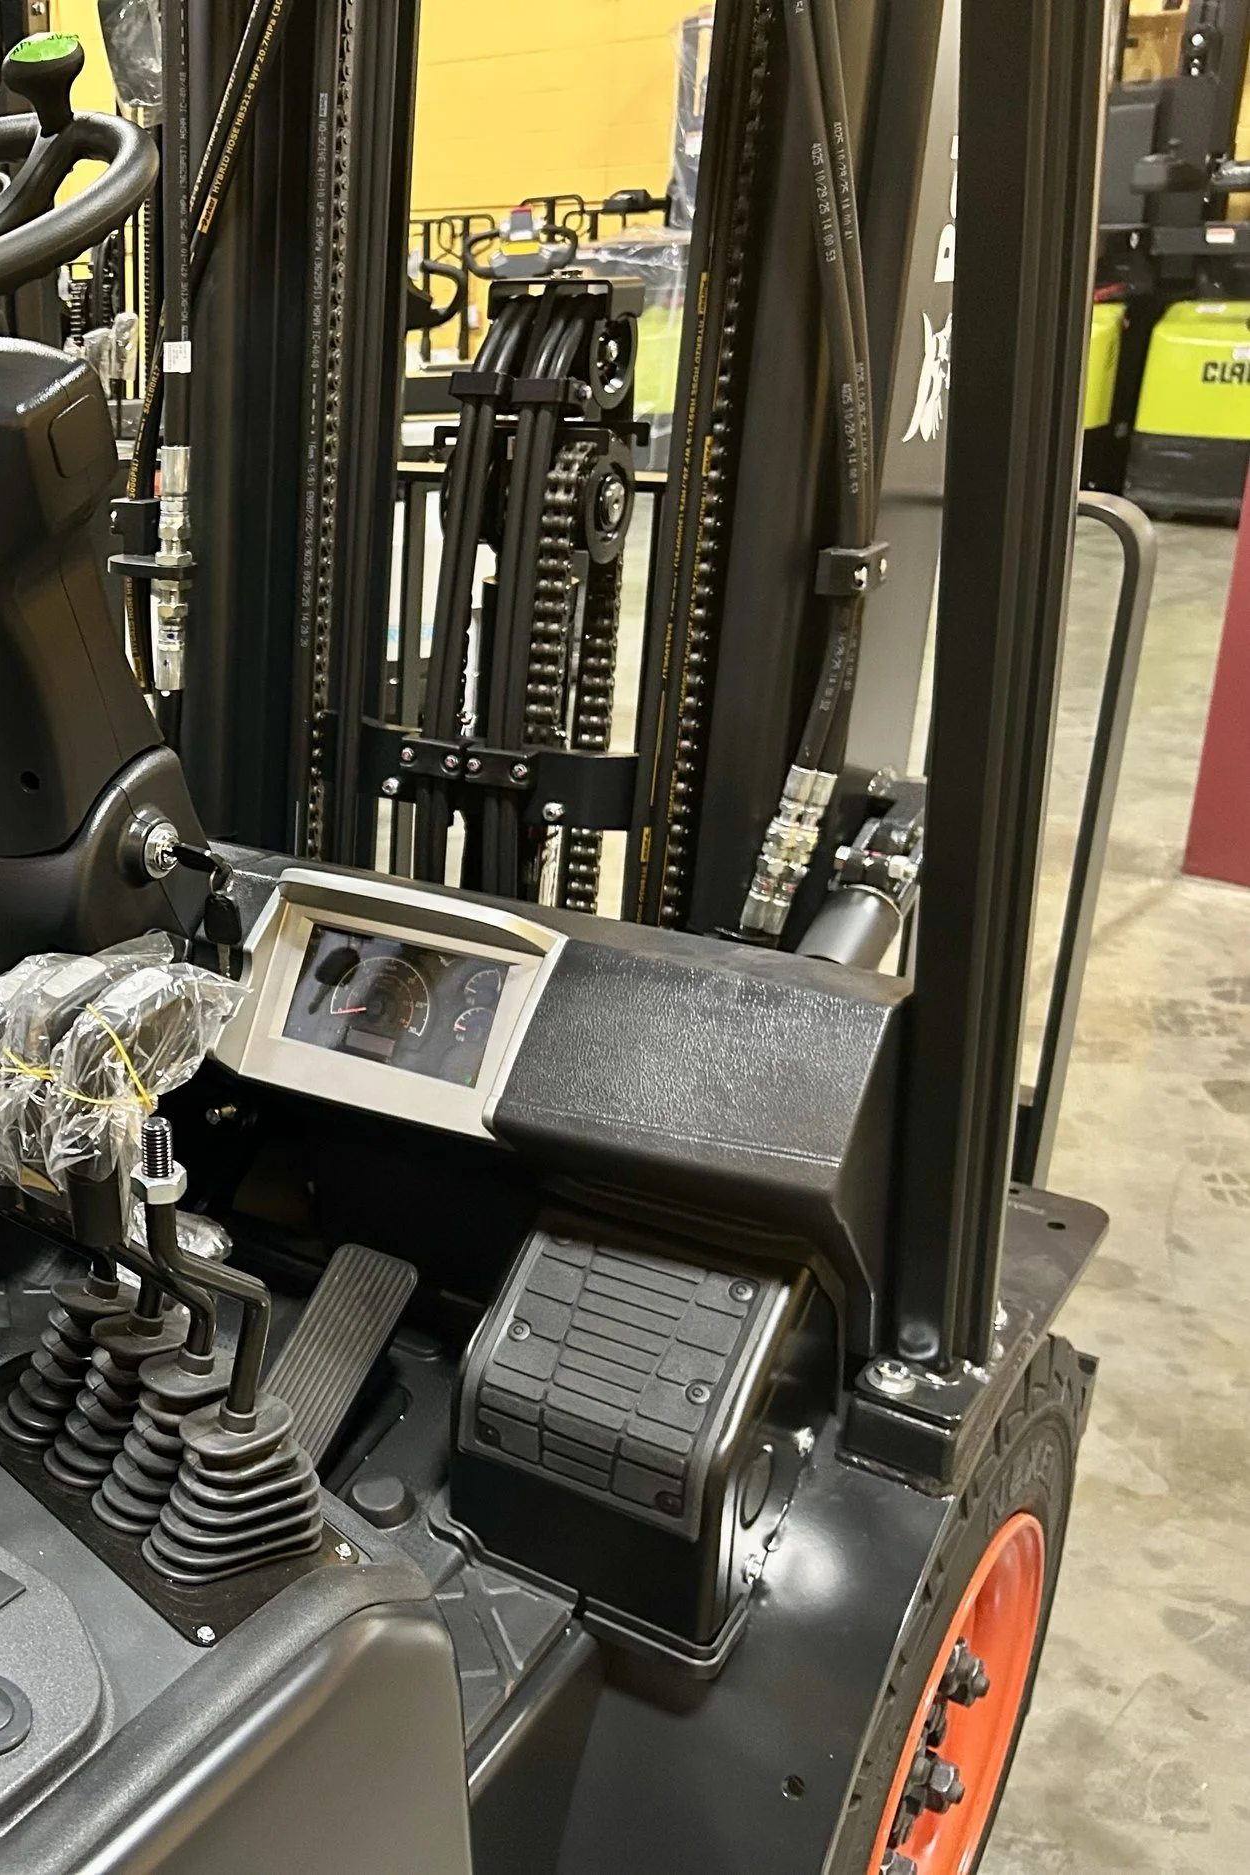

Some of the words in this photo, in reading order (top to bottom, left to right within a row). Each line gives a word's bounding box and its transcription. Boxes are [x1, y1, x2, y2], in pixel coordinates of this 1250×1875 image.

[254, 17, 278, 63] 20.7MPa
[248, 63, 262, 82] WP
[224, 126, 241, 154] HOSE
[809, 141, 824, 166] 4025
[210, 154, 231, 194] HYBRID
[812, 169, 831, 214] 10/29/25
[196, 195, 218, 231] Parker
